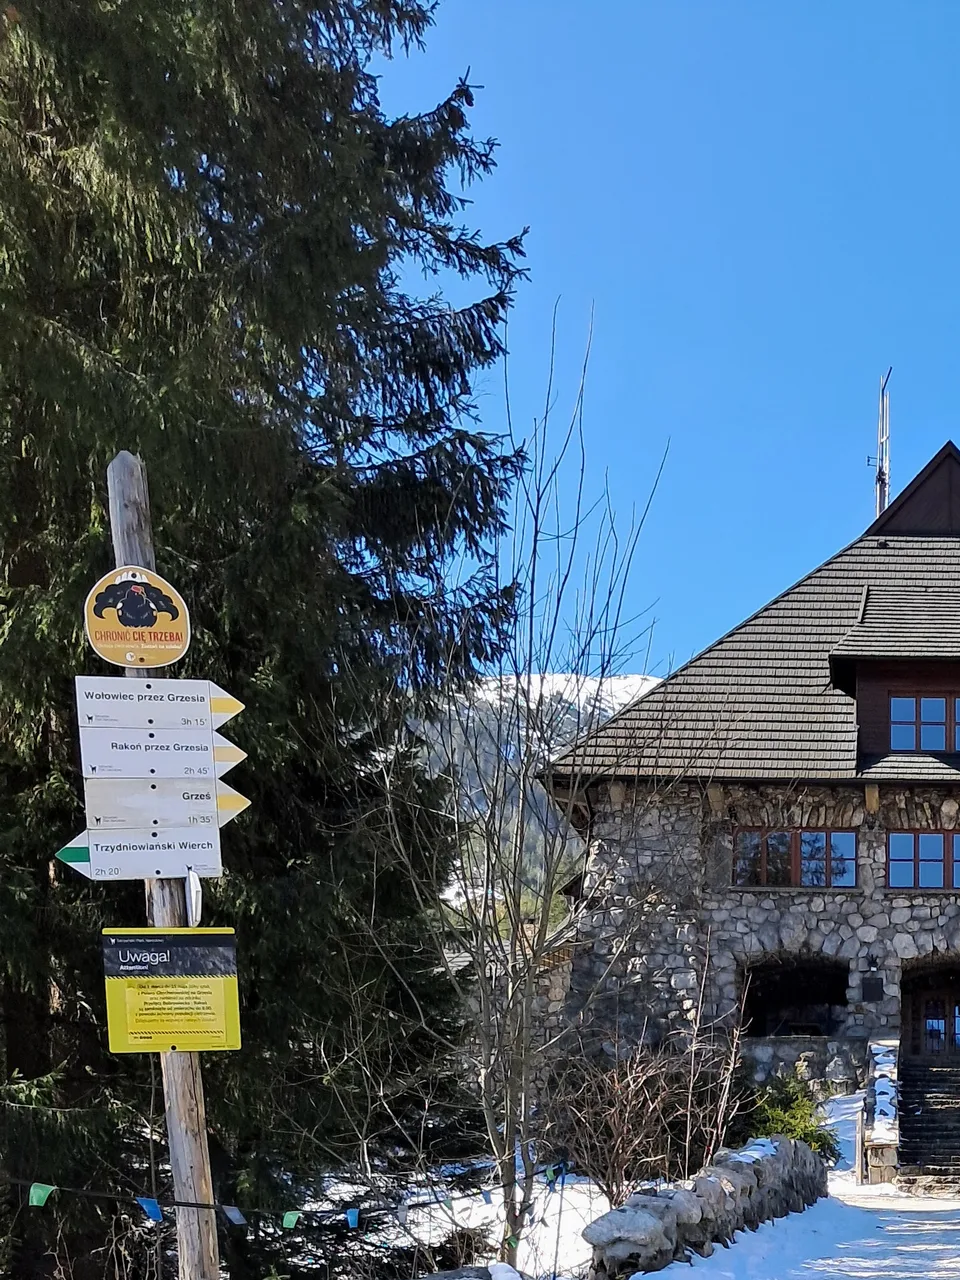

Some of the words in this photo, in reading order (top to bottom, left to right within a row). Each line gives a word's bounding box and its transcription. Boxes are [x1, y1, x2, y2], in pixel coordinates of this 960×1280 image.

[132, 631, 146, 643] CIĘ
[148, 631, 183, 642] TRZEBA!
[84, 691, 134, 701] Wołowiec
[137, 693, 164, 703] przez
[168, 693, 205, 703] Grzesia
[181, 718, 192, 726] 3h
[195, 718, 207, 726] 15'
[111, 742, 142, 750] Rakoń
[145, 744, 170, 752] przez
[173, 743, 209, 752] Grzesia
[184, 767, 196, 775] 2h
[197, 767, 210, 775] 45'
[182, 791, 211, 801] Grześ
[188, 816, 198, 824] 1h
[200, 816, 213, 824] 35'
[93, 843, 175, 852] Trzydniowiański
[178, 841, 213, 850] Wierch
[95, 868, 107, 876] 2h
[118, 949, 170, 965] Uwaga!
